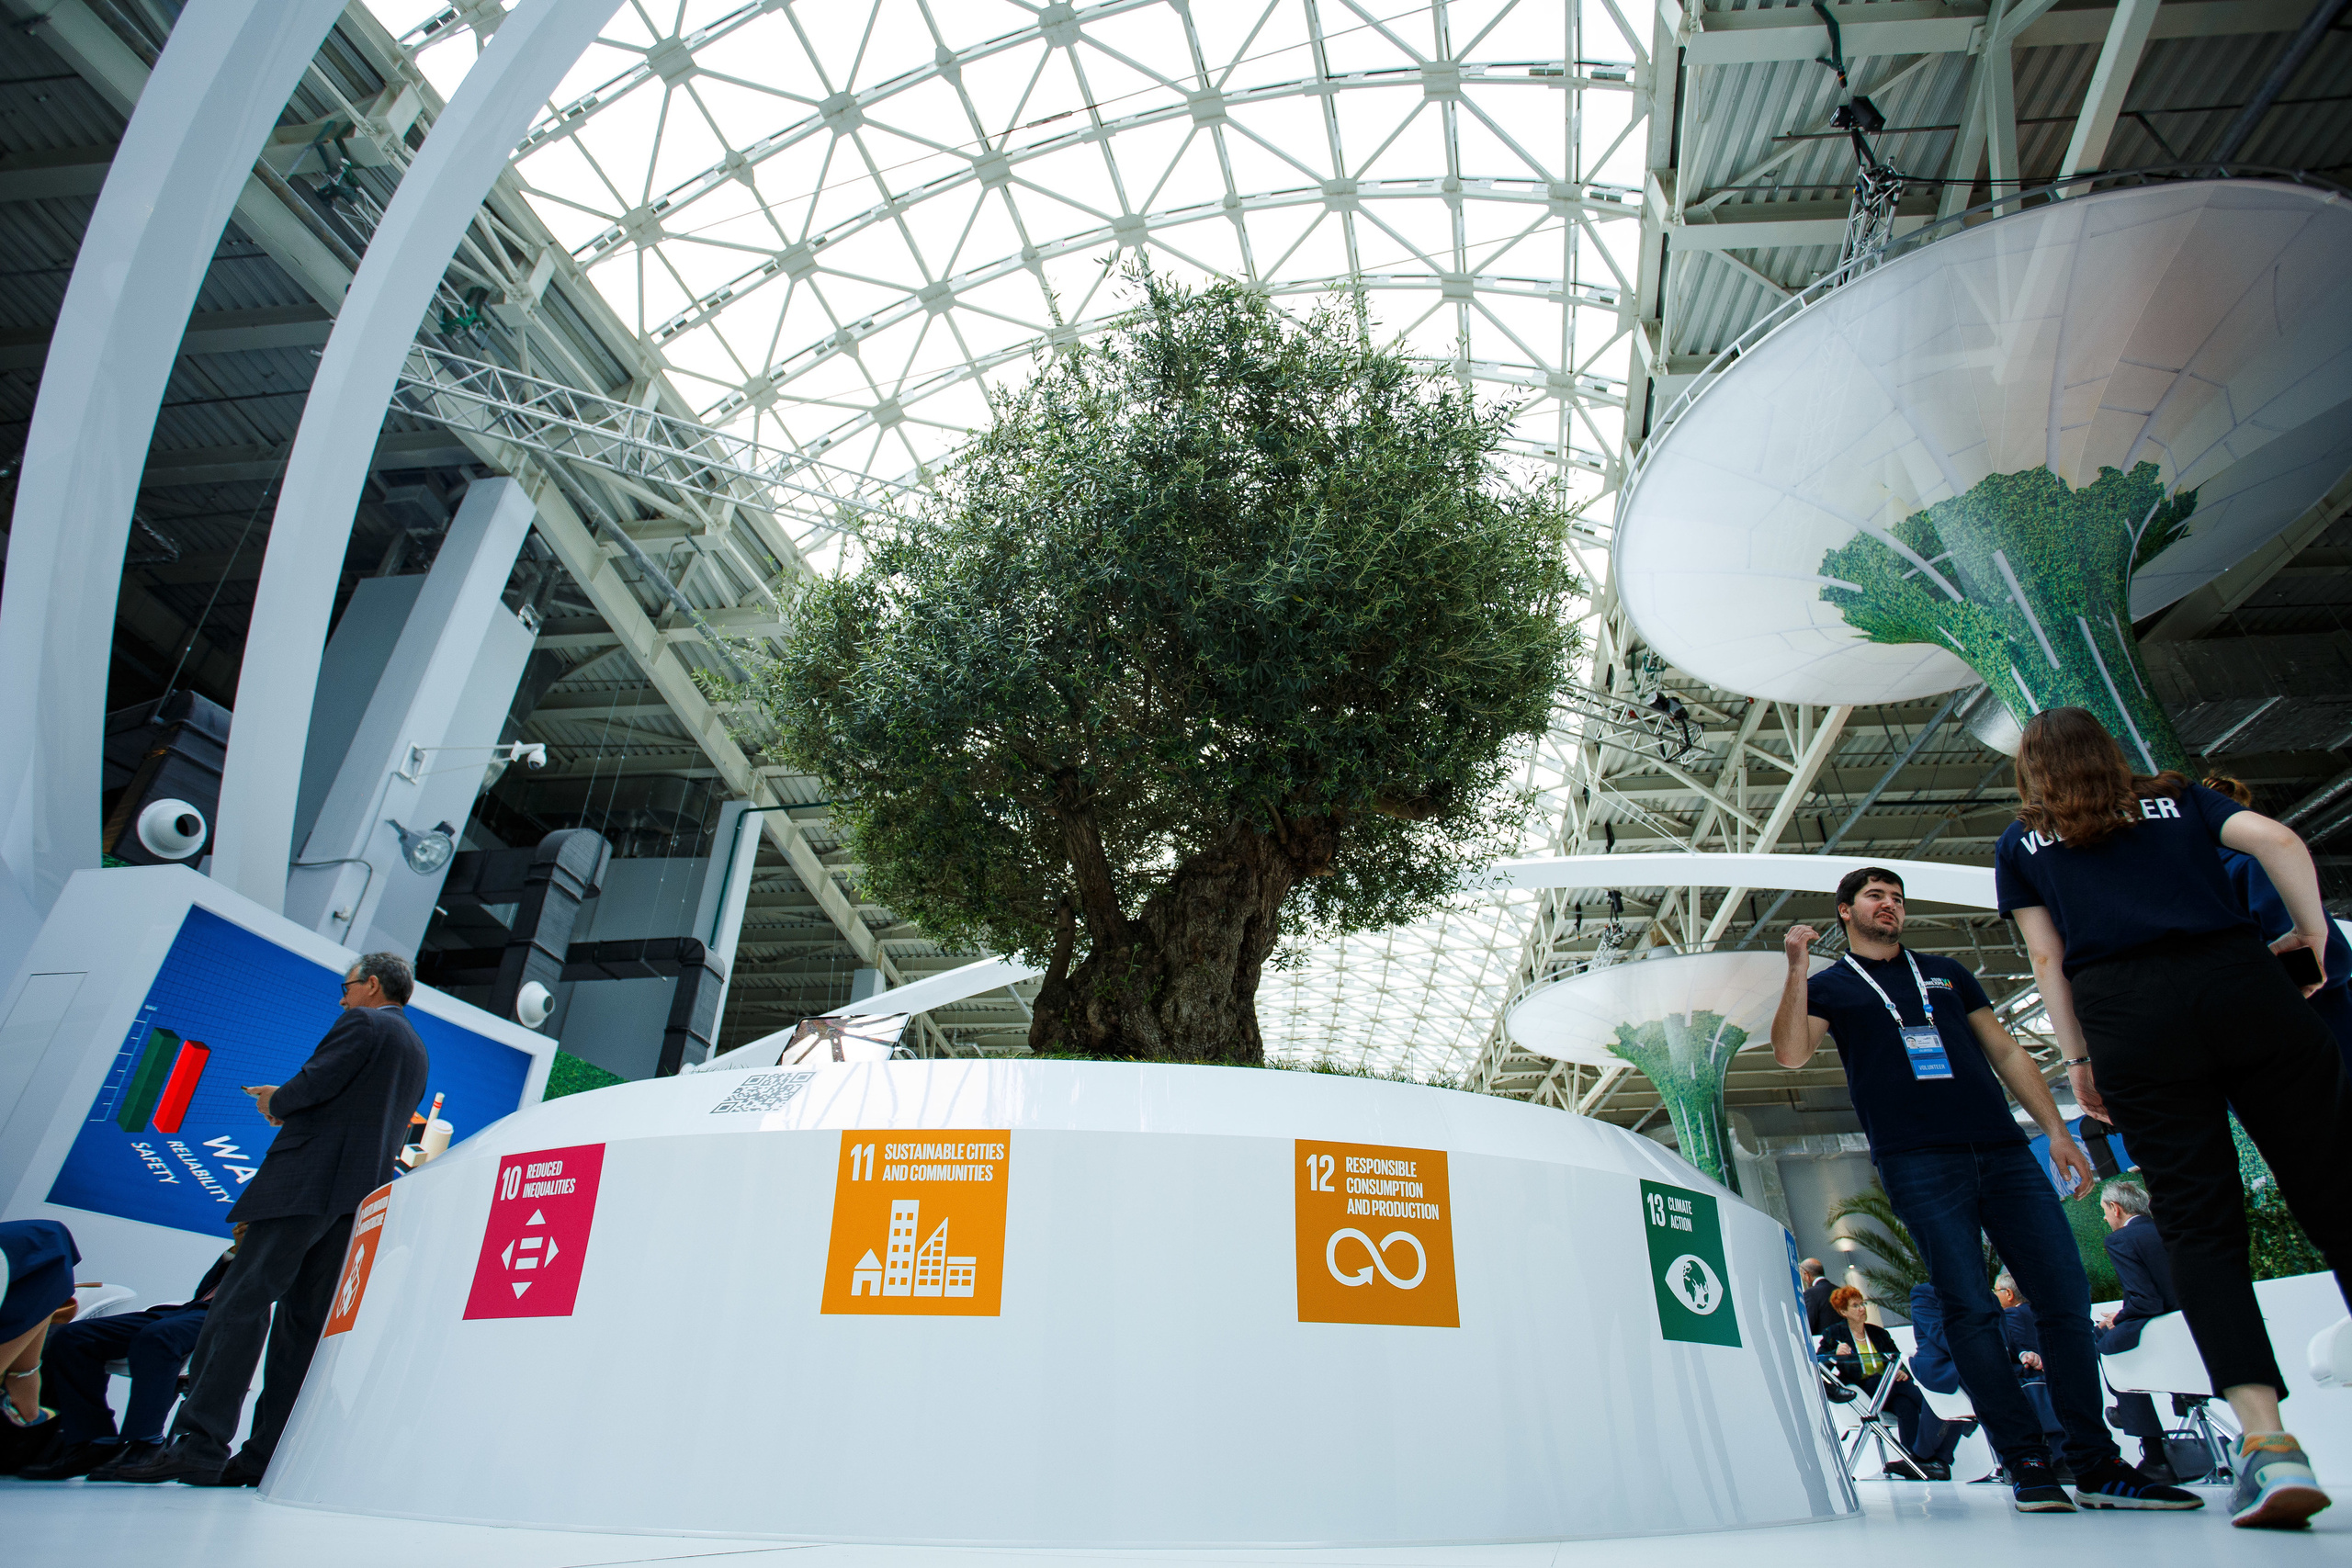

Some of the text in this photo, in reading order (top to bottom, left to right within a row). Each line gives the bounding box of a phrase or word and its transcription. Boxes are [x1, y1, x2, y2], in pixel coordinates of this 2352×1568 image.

[850, 1144, 876, 1181] 11
[884, 1143, 1005, 1160] SUSTAINABLE CITIES
[130, 1142, 182, 1185] SAFETY
[166, 1140, 236, 1204] RELIABILITY
[526, 1160, 563, 1179] REDUCED
[882, 1164, 994, 1181] AND COMMUNITIES
[1306, 1154, 1335, 1192] 12
[1345, 1156, 1418, 1178] RESPONSIBLE
[500, 1165, 523, 1201] 10
[522, 1178, 576, 1199] INEQUALITIES
[1346, 1177, 1424, 1199] CONSUMPTION
[1347, 1198, 1440, 1221] AND PRODUCTION
[1647, 1192, 1667, 1227] 13
[1668, 1196, 1693, 1215] CLIMATE
[1670, 1213, 1693, 1233] ACTION
